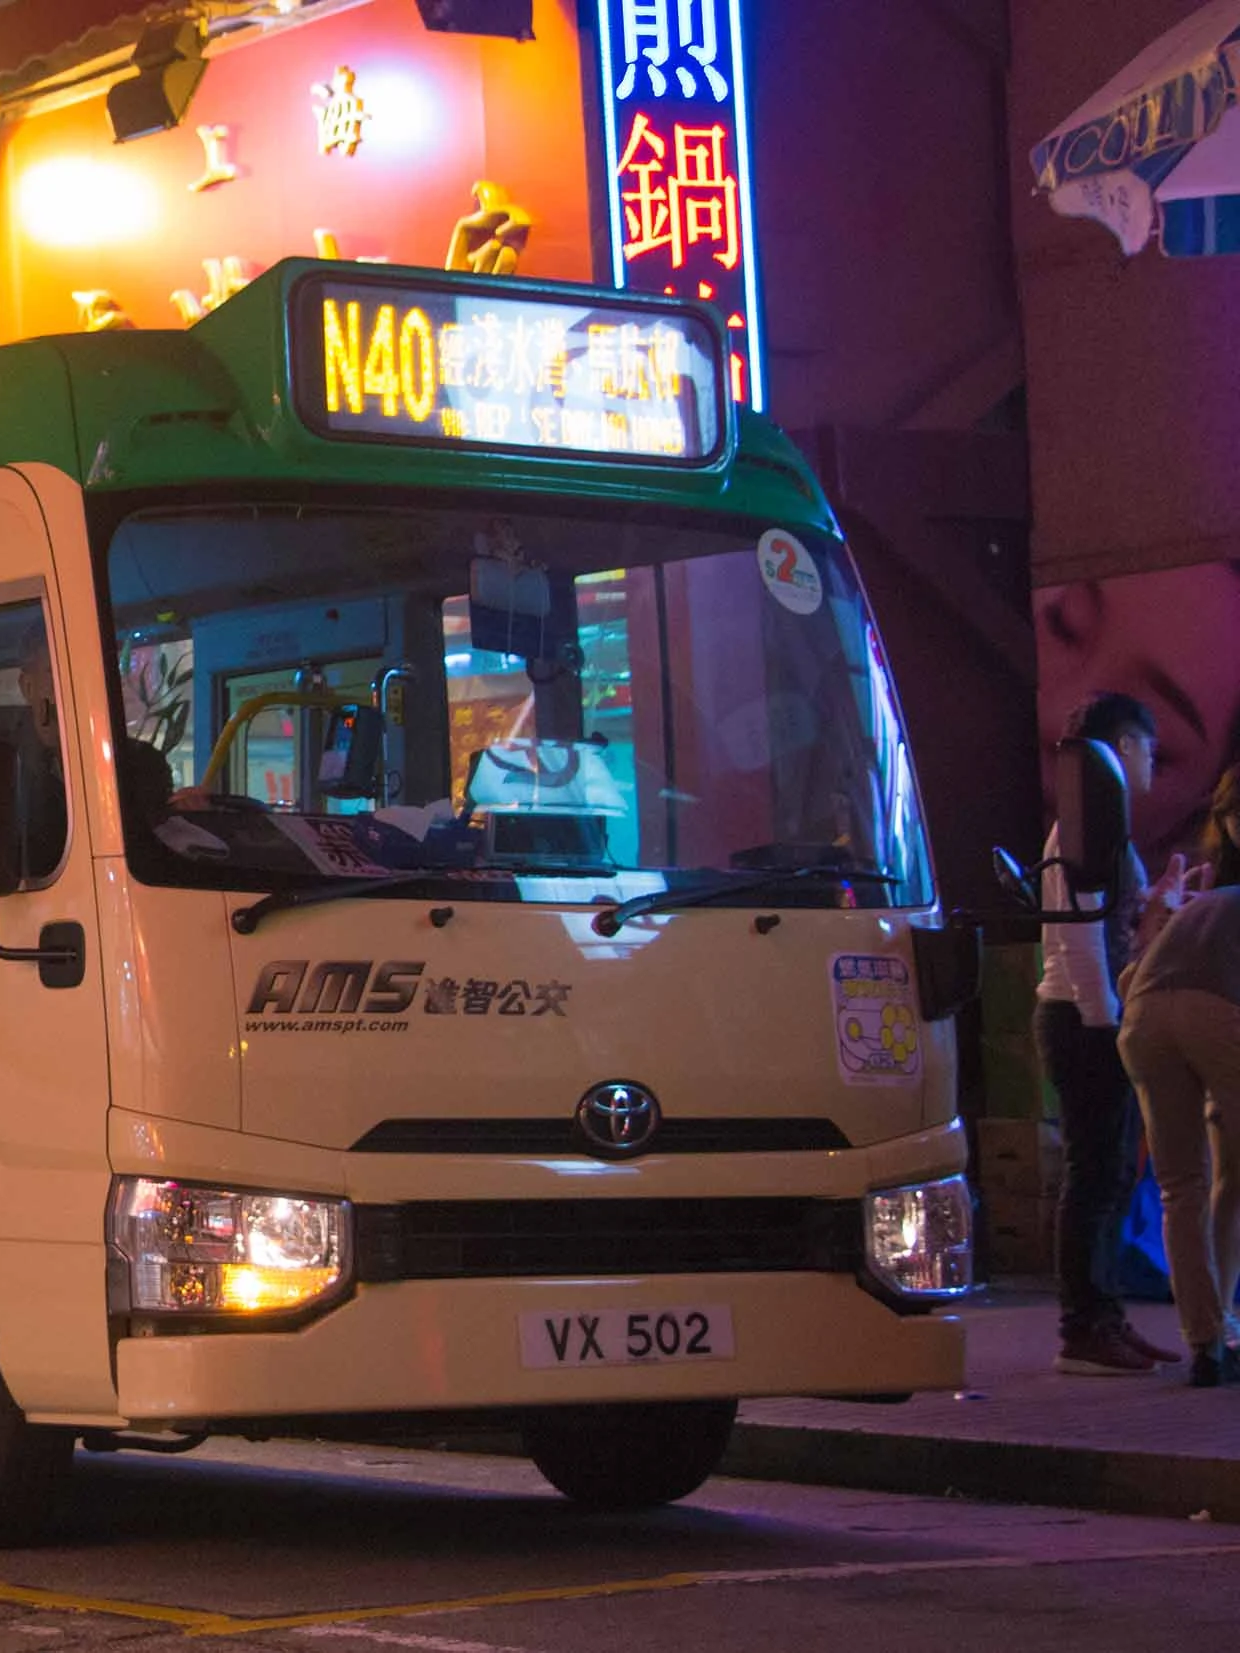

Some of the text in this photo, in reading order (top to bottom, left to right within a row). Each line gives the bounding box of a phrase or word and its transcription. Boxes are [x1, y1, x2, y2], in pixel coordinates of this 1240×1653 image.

[615, 0, 745, 402] 煎鍋
[323, 298, 436, 423] N40
[246, 959, 426, 1014] AMS
[245, 1018, 409, 1035] www.amspt.com
[545, 1311, 712, 1361] VX 502
